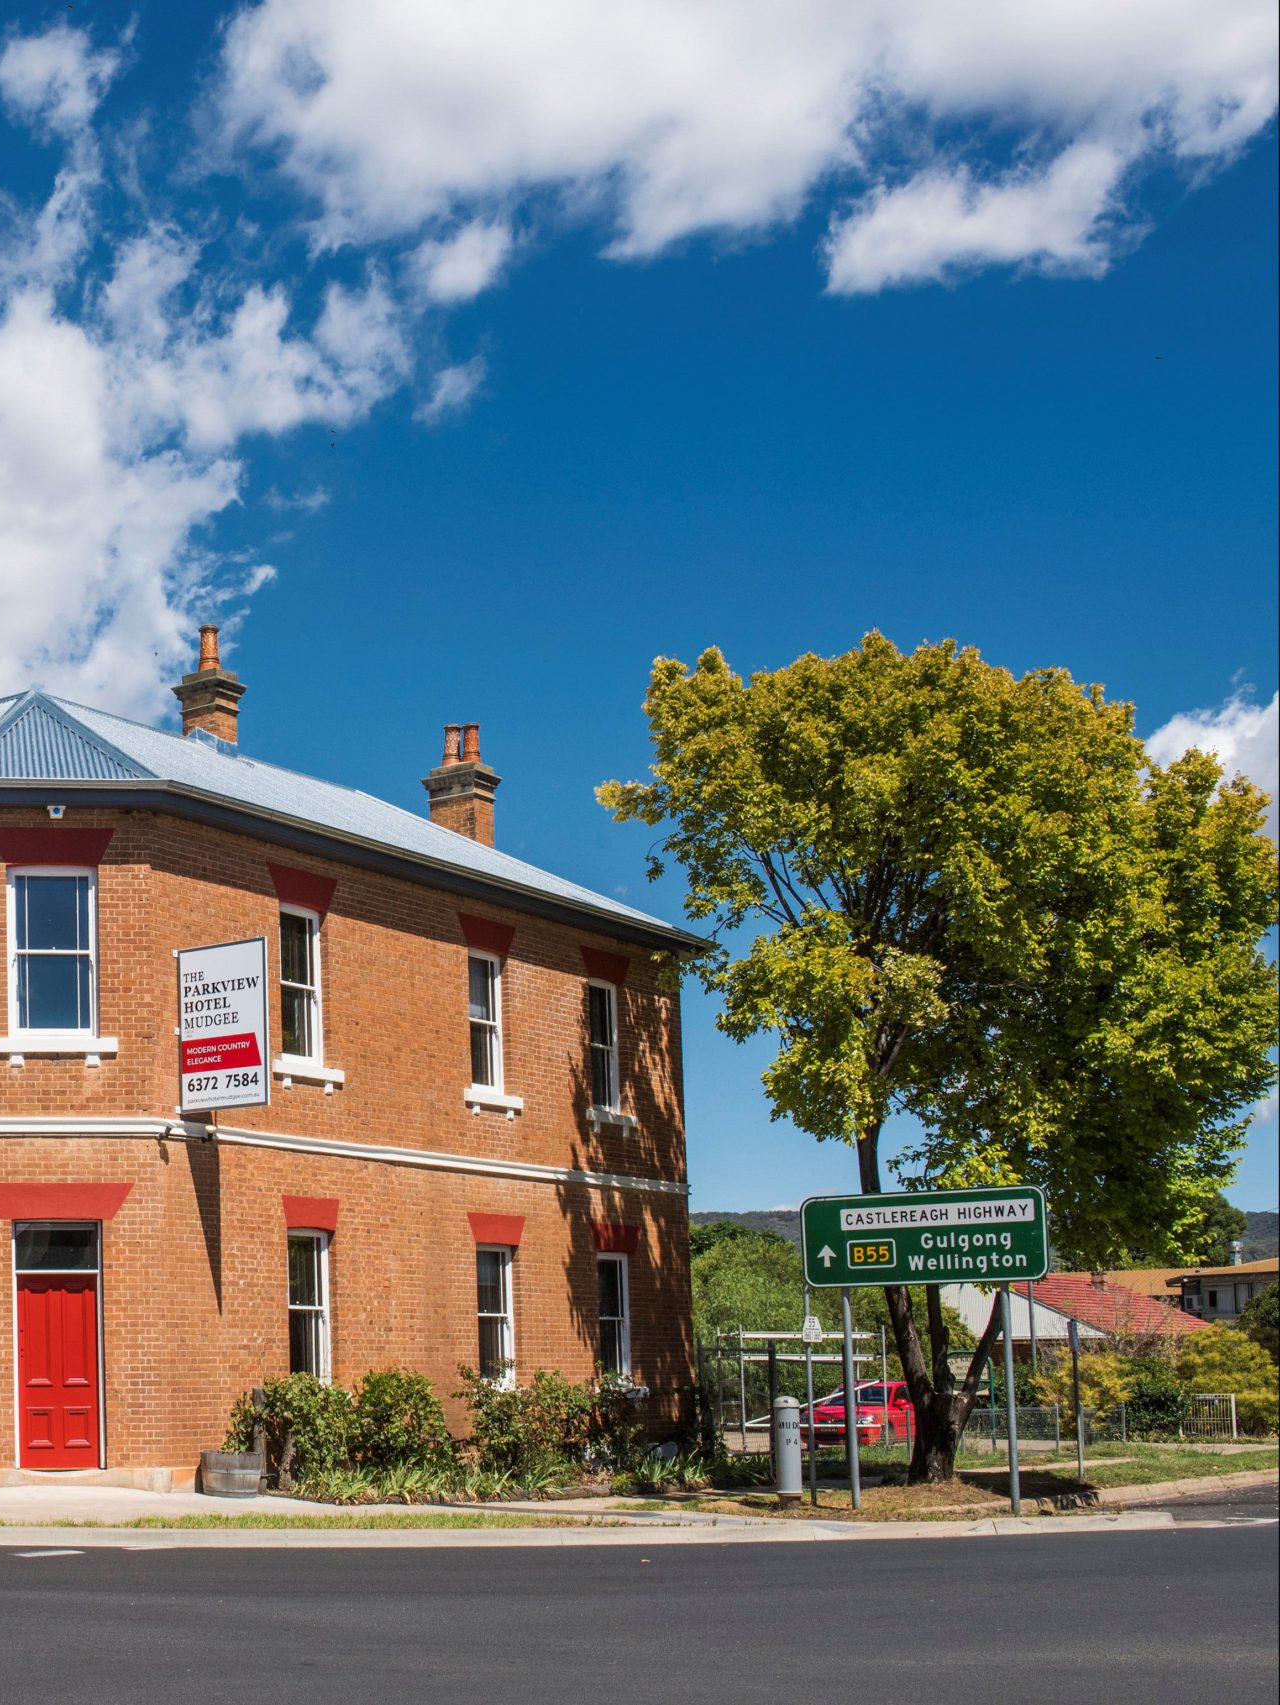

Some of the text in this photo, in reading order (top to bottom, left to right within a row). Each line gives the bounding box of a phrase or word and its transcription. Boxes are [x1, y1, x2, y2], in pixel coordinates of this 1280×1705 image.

[183, 971, 204, 984] THE
[184, 976, 259, 998] PARKVIEW
[184, 998, 230, 1014] HOTEL
[184, 1012, 239, 1030] MUDGEE
[186, 1041, 251, 1055] MODERN COUNTRY
[187, 1055, 222, 1066] ELEGANCE
[187, 1072, 259, 1093] 6372 7584
[845, 1203, 1029, 1226] CASTLEREAGH HIGHWAY
[920, 1232, 1012, 1252] Gulgong
[853, 1246, 890, 1264] B55
[908, 1252, 1027, 1274] Wellington
